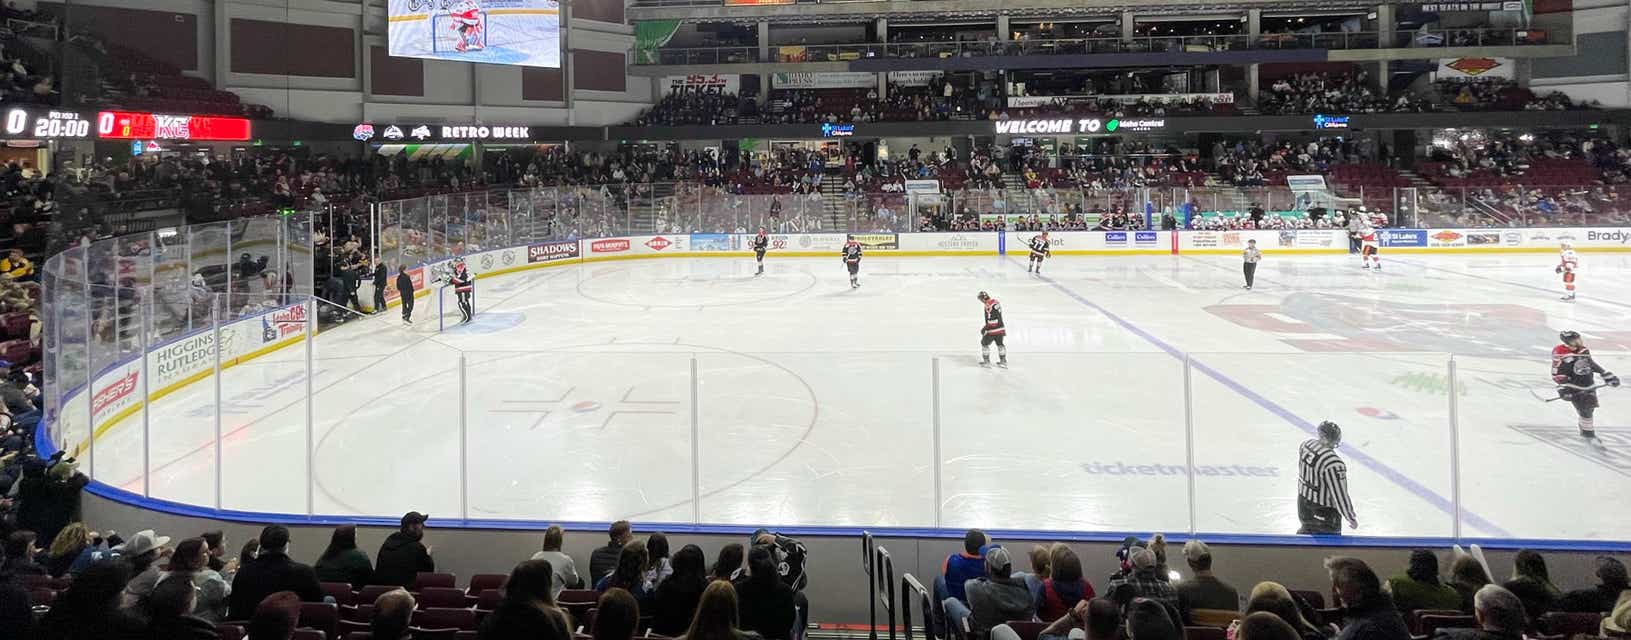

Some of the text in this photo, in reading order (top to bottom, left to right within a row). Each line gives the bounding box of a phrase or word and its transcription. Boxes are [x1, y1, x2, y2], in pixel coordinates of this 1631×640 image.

[671, 84, 726, 96] TICKET
[7, 109, 27, 134] 0
[35, 119, 89, 137] 20:00
[100, 112, 115, 133] 0
[995, 119, 1101, 134] WELCOME TO
[123, 126, 130, 137] 0
[442, 126, 529, 138] RETRO WEEK
[1587, 229, 1628, 244] Brady
[530, 241, 577, 258] SHADOWS
[157, 333, 214, 364] HIGGINS
[158, 344, 224, 377] RUTLEDGE
[1081, 460, 1280, 478] ticketmaster
